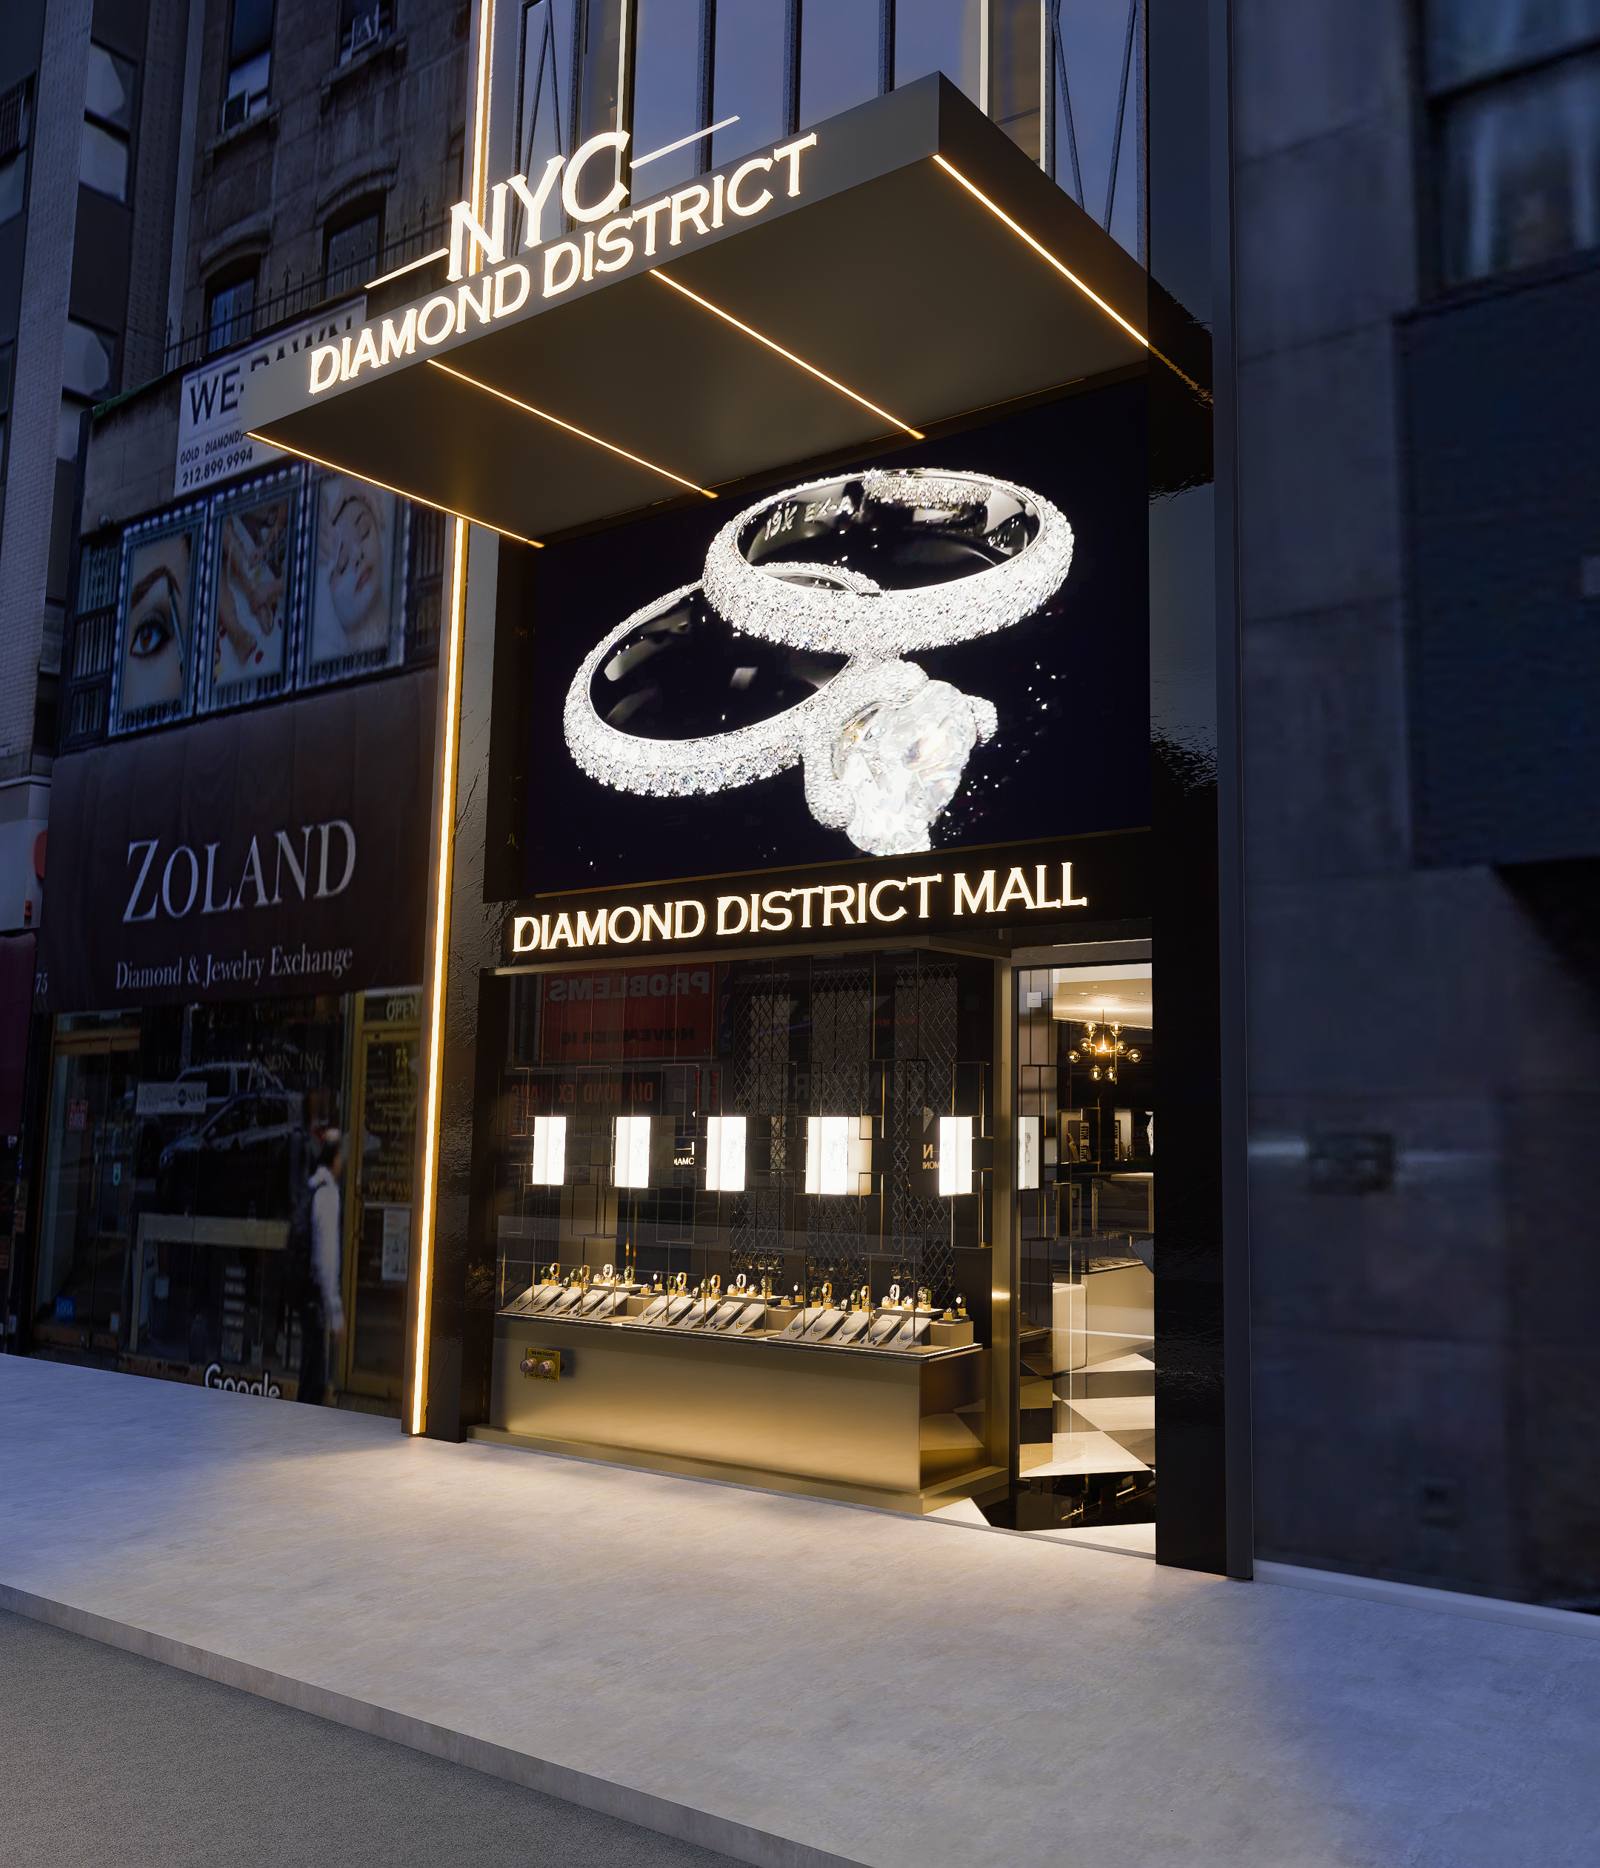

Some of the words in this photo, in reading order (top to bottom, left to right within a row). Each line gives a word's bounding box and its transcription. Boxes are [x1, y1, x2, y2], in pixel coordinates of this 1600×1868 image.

[446, 129, 633, 282] NYC
[309, 262, 531, 395] DIAMOND
[543, 132, 819, 299] DISTRICT
[180, 446, 200, 465] GOLD
[182, 447, 253, 487] 212.899.9994
[123, 819, 357, 924] ZOLAND
[512, 898, 706, 953] DIAMOND
[716, 873, 943, 936] DISTRICT
[953, 861, 1088, 916] MALL
[35, 972, 48, 994] 75
[115, 956, 182, 991] Diamond
[187, 956, 200, 984] &
[202, 949, 265, 989] Jewelry
[270, 943, 354, 980] Exchange
[386, 997, 420, 1022] OPEN
